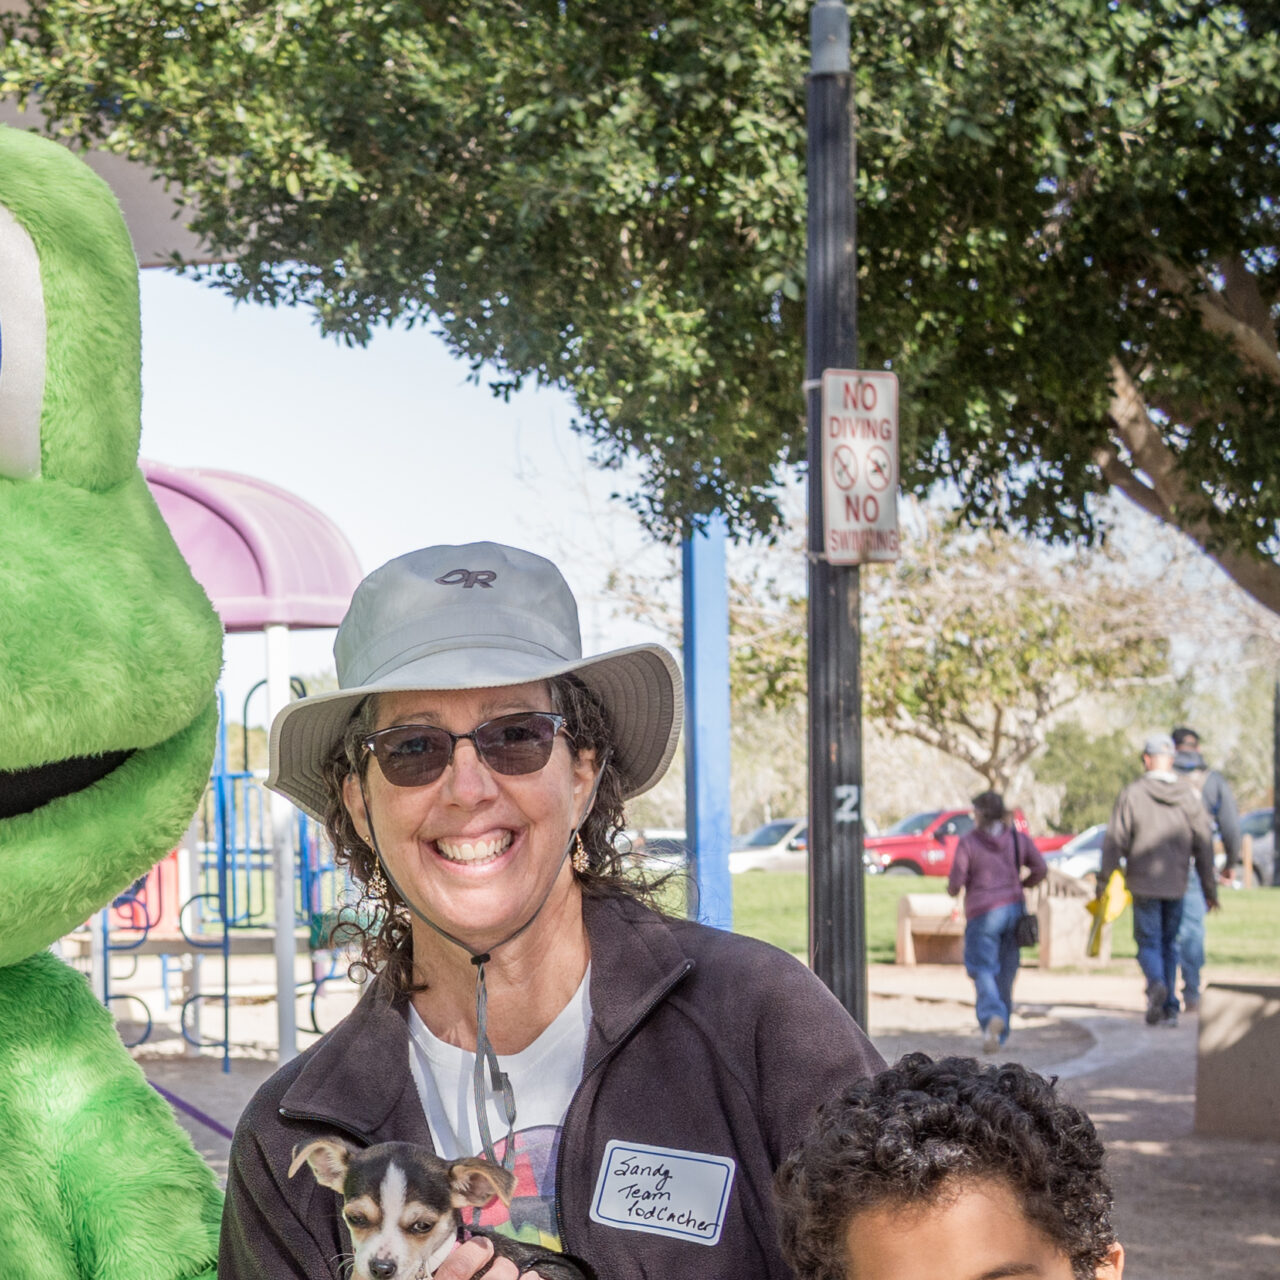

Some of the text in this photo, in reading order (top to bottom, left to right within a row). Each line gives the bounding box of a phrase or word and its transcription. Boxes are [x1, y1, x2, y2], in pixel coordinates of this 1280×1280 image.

[844, 381, 878, 411] NO
[829, 416, 892, 441] DIVING
[845, 494, 880, 523] NO
[834, 784, 859, 821] 2
[617, 1183, 671, 1201] Team
